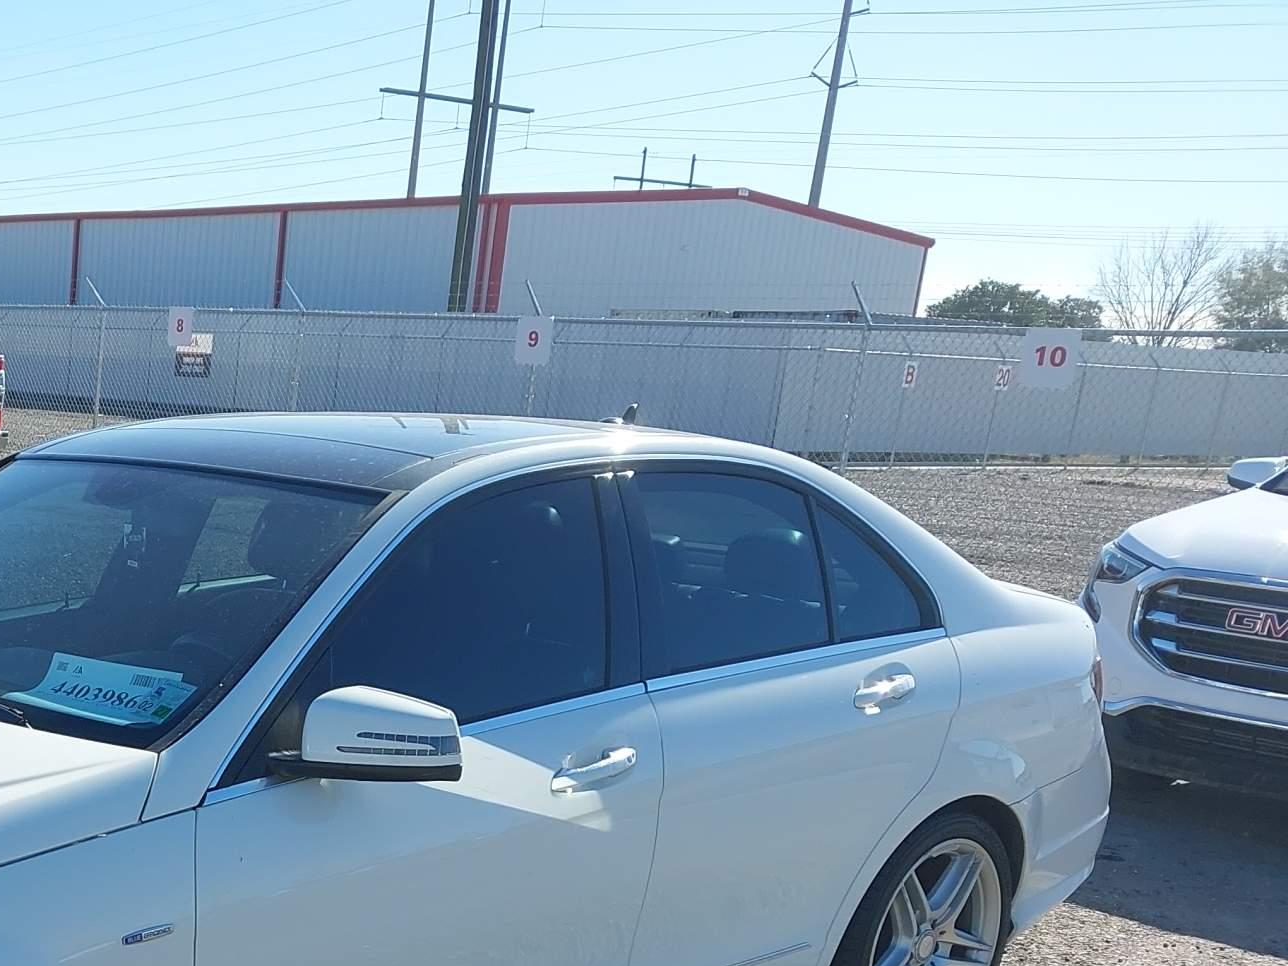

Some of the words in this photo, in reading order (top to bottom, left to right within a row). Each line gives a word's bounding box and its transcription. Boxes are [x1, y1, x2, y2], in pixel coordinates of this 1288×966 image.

[176, 318, 184, 333] 8
[527, 330, 539, 348] 9
[1035, 346, 1067, 368] 10
[904, 364, 916, 385] B
[996, 368, 1011, 387] 20
